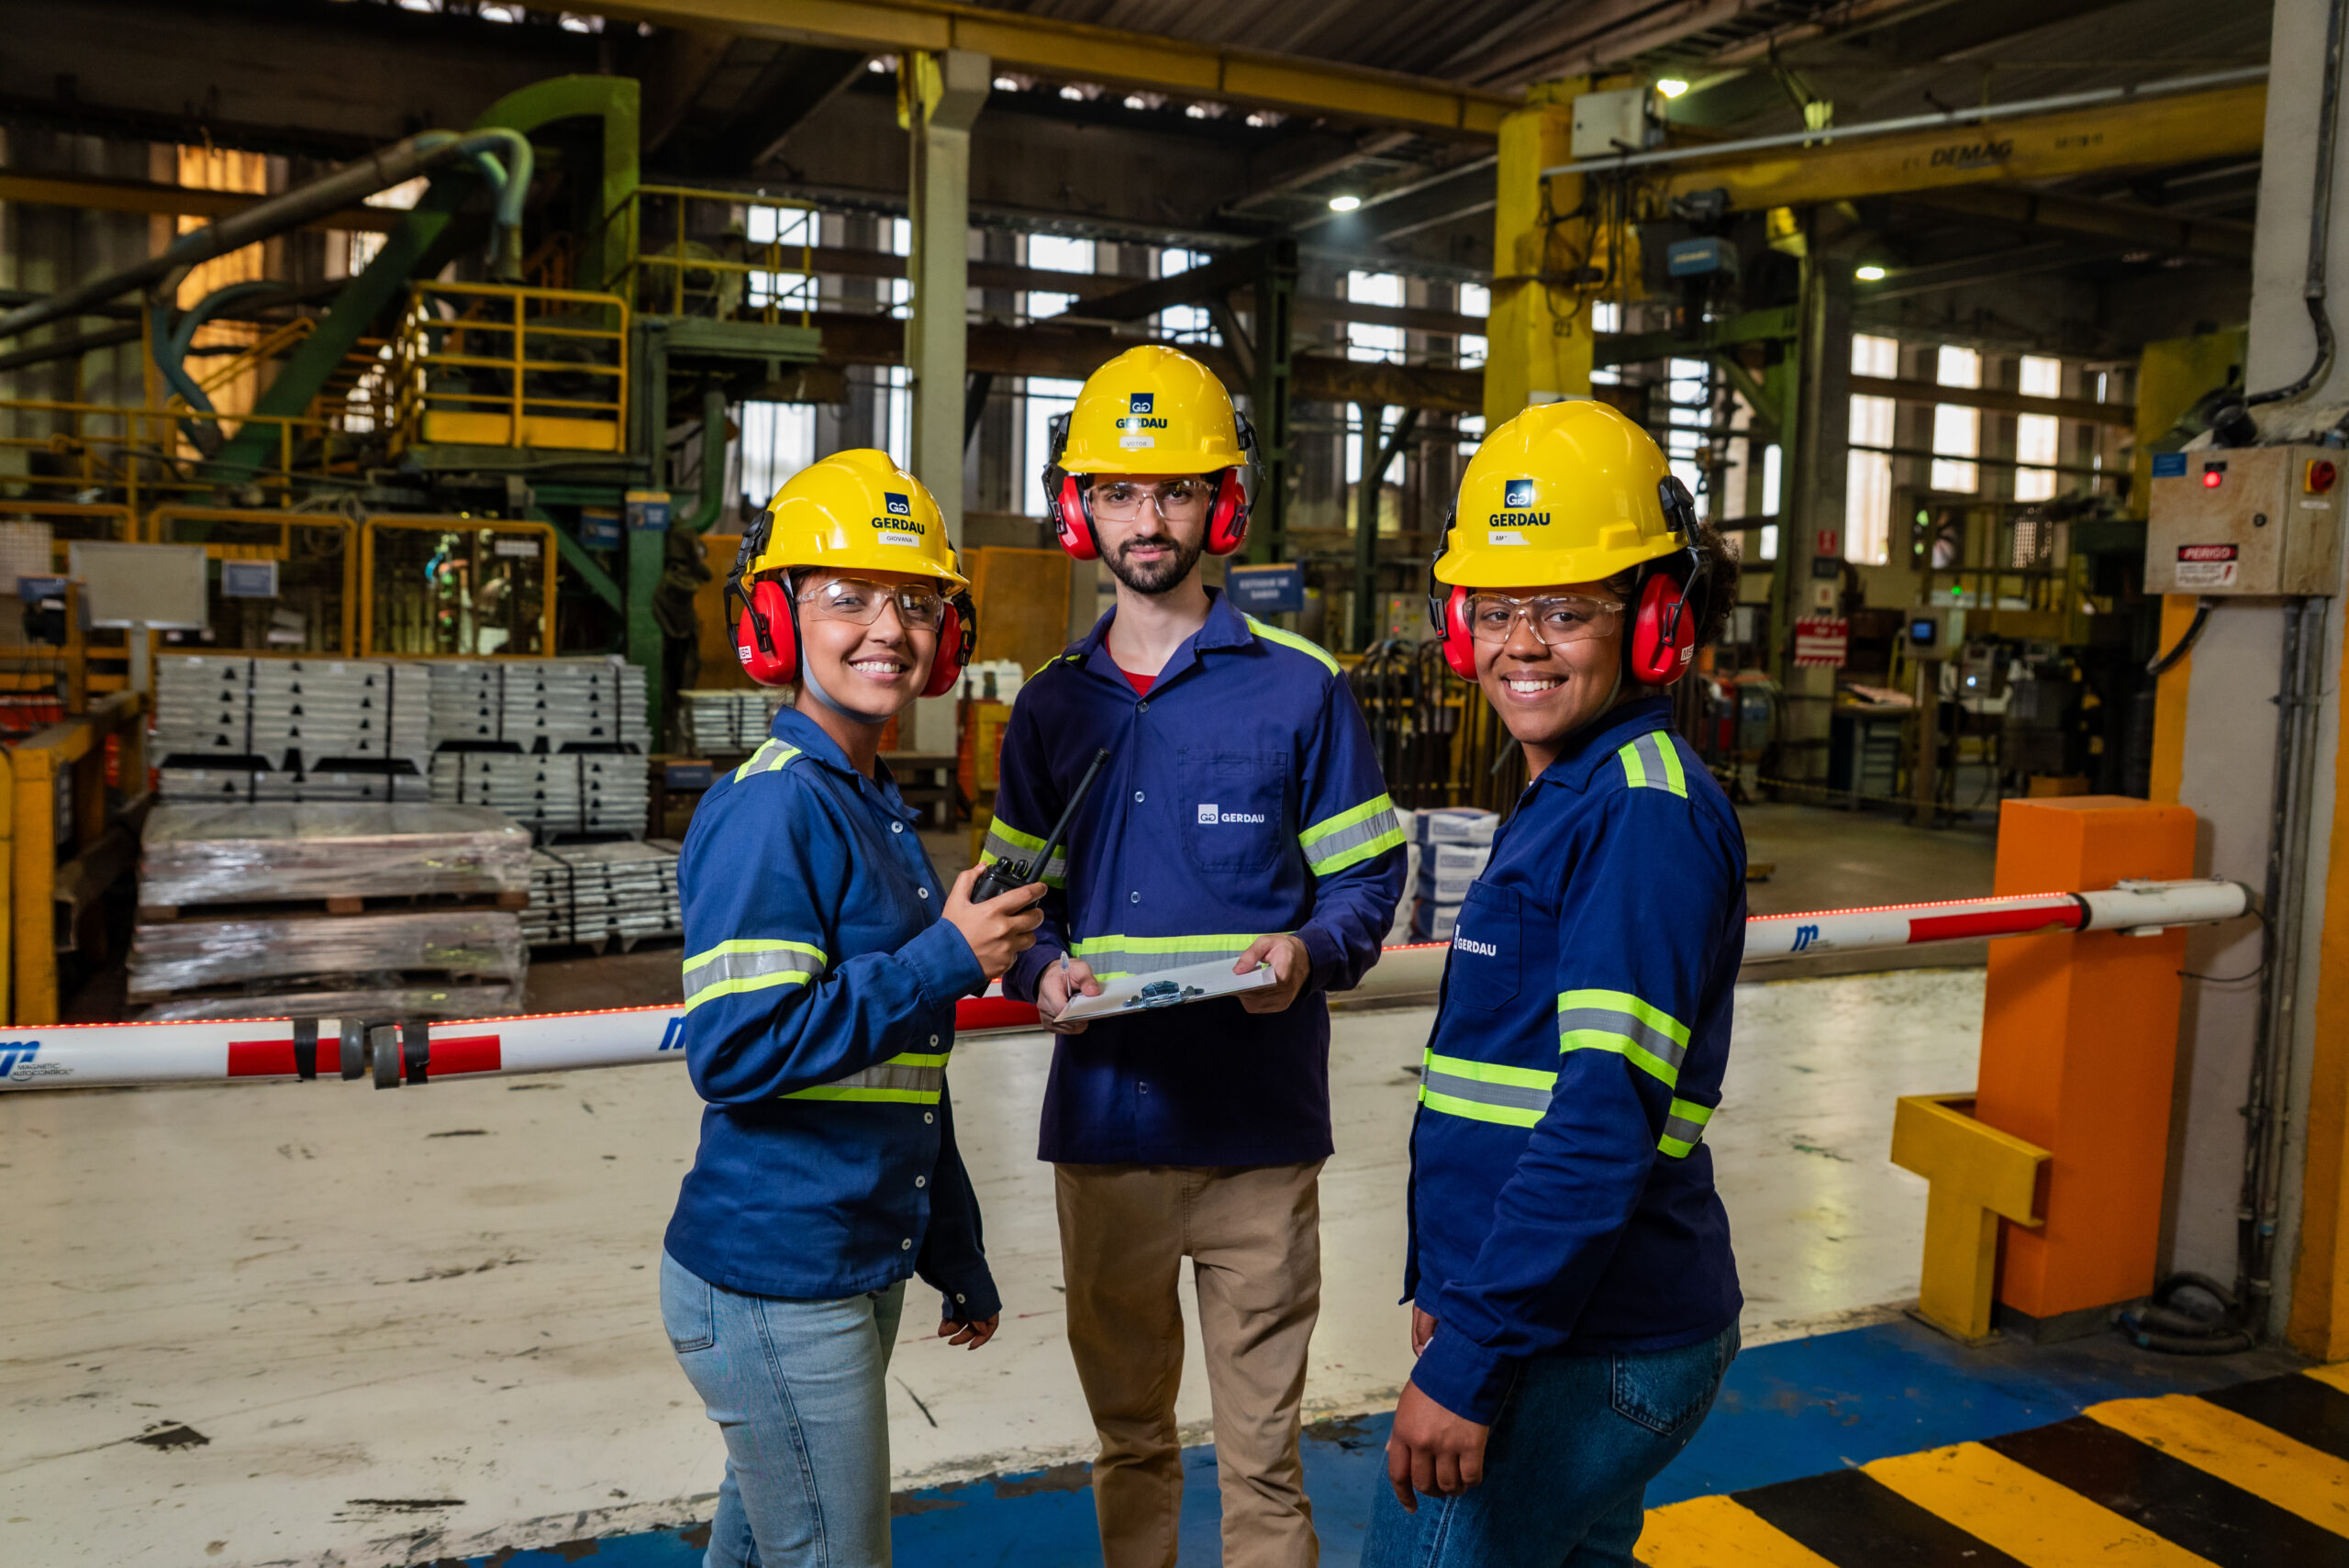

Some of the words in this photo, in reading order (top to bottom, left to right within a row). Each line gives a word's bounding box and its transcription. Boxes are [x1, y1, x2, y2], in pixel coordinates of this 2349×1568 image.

[1931, 140, 2014, 167] DEMAG
[1116, 417, 1167, 429] GEDAU
[872, 517, 925, 535] GERDAU
[1489, 512, 1551, 528] GERDAU
[2185, 546, 2230, 560] PERIGO
[1221, 813, 1265, 823] GERDAU
[1458, 937, 1497, 957] GERDAU
[17, 1062, 61, 1071] MAGNETIC
